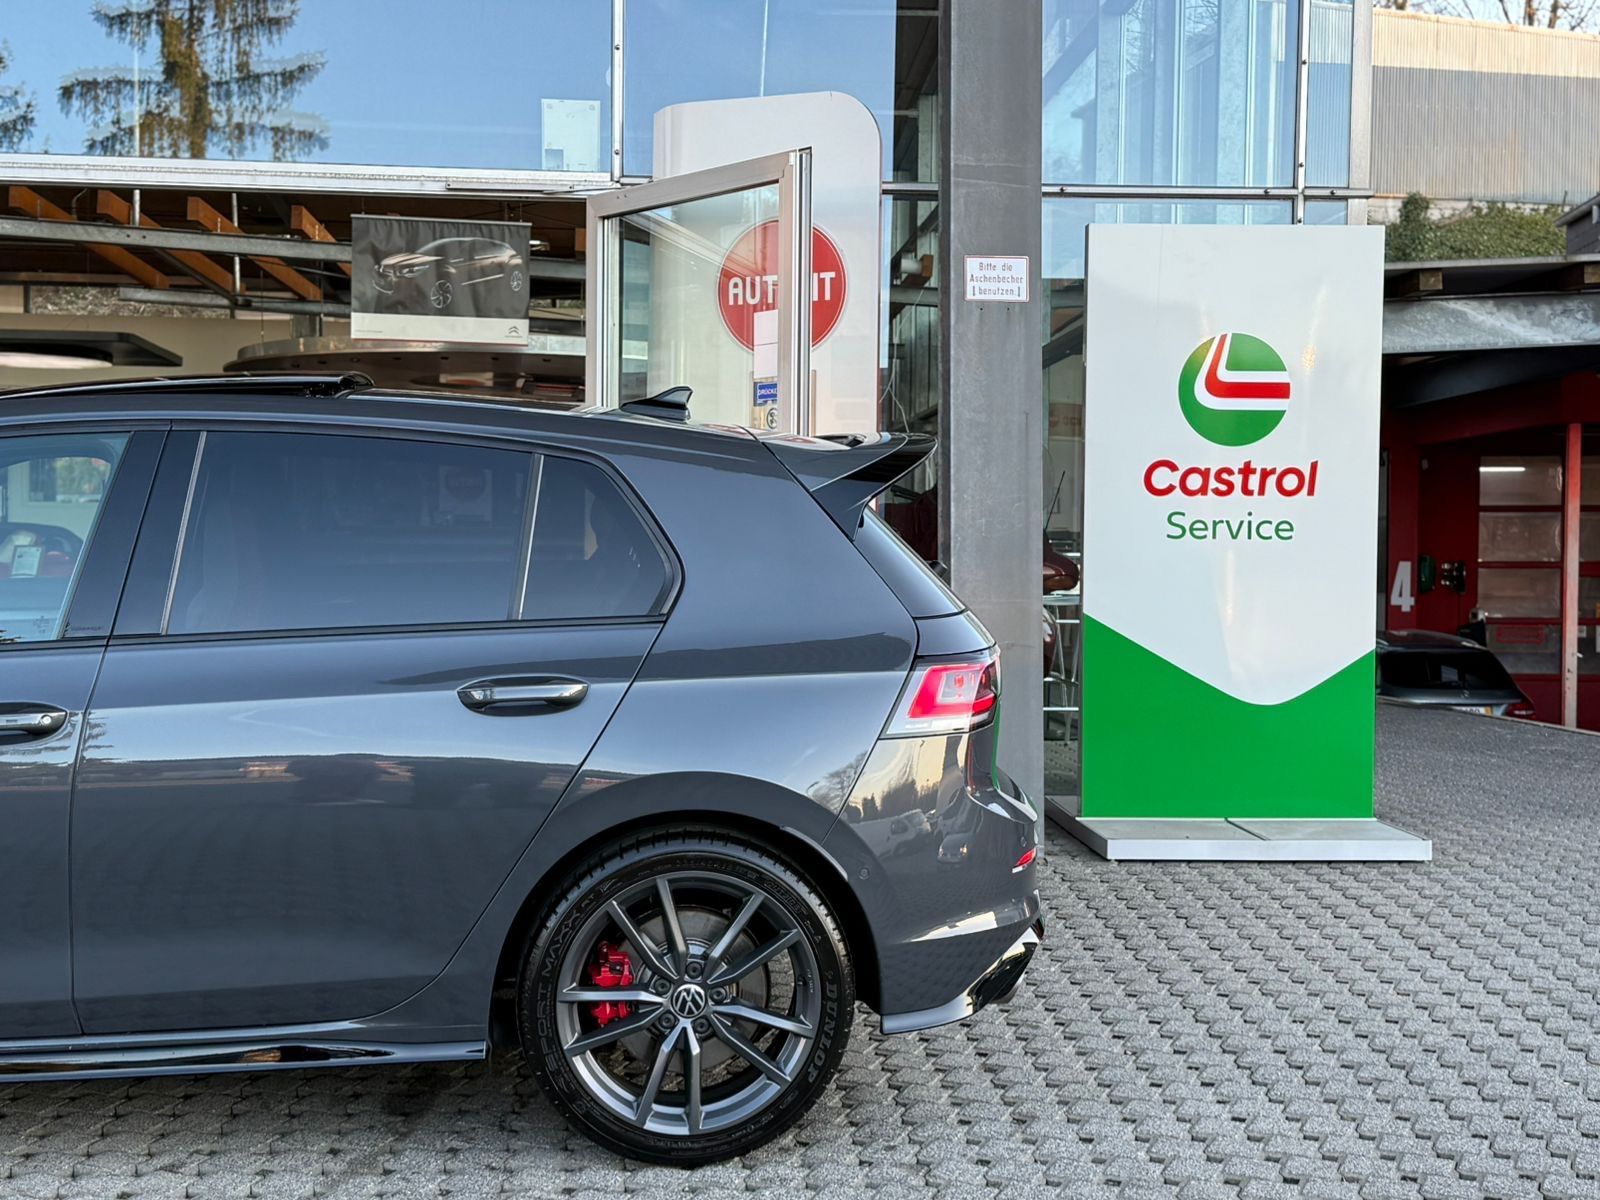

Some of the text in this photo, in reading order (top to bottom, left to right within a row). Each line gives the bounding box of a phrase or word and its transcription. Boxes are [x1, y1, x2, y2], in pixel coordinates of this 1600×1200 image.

[969, 273, 1023, 284] Aschenbecher
[979, 262, 1013, 271] Bitte die
[728, 271, 836, 306] AUTIT
[1143, 459, 1319, 498] Castrol
[1166, 511, 1294, 541] Service
[1390, 560, 1415, 613] 4
[541, 910, 580, 977] MAXX
[807, 981, 838, 1084] DUNLOP
